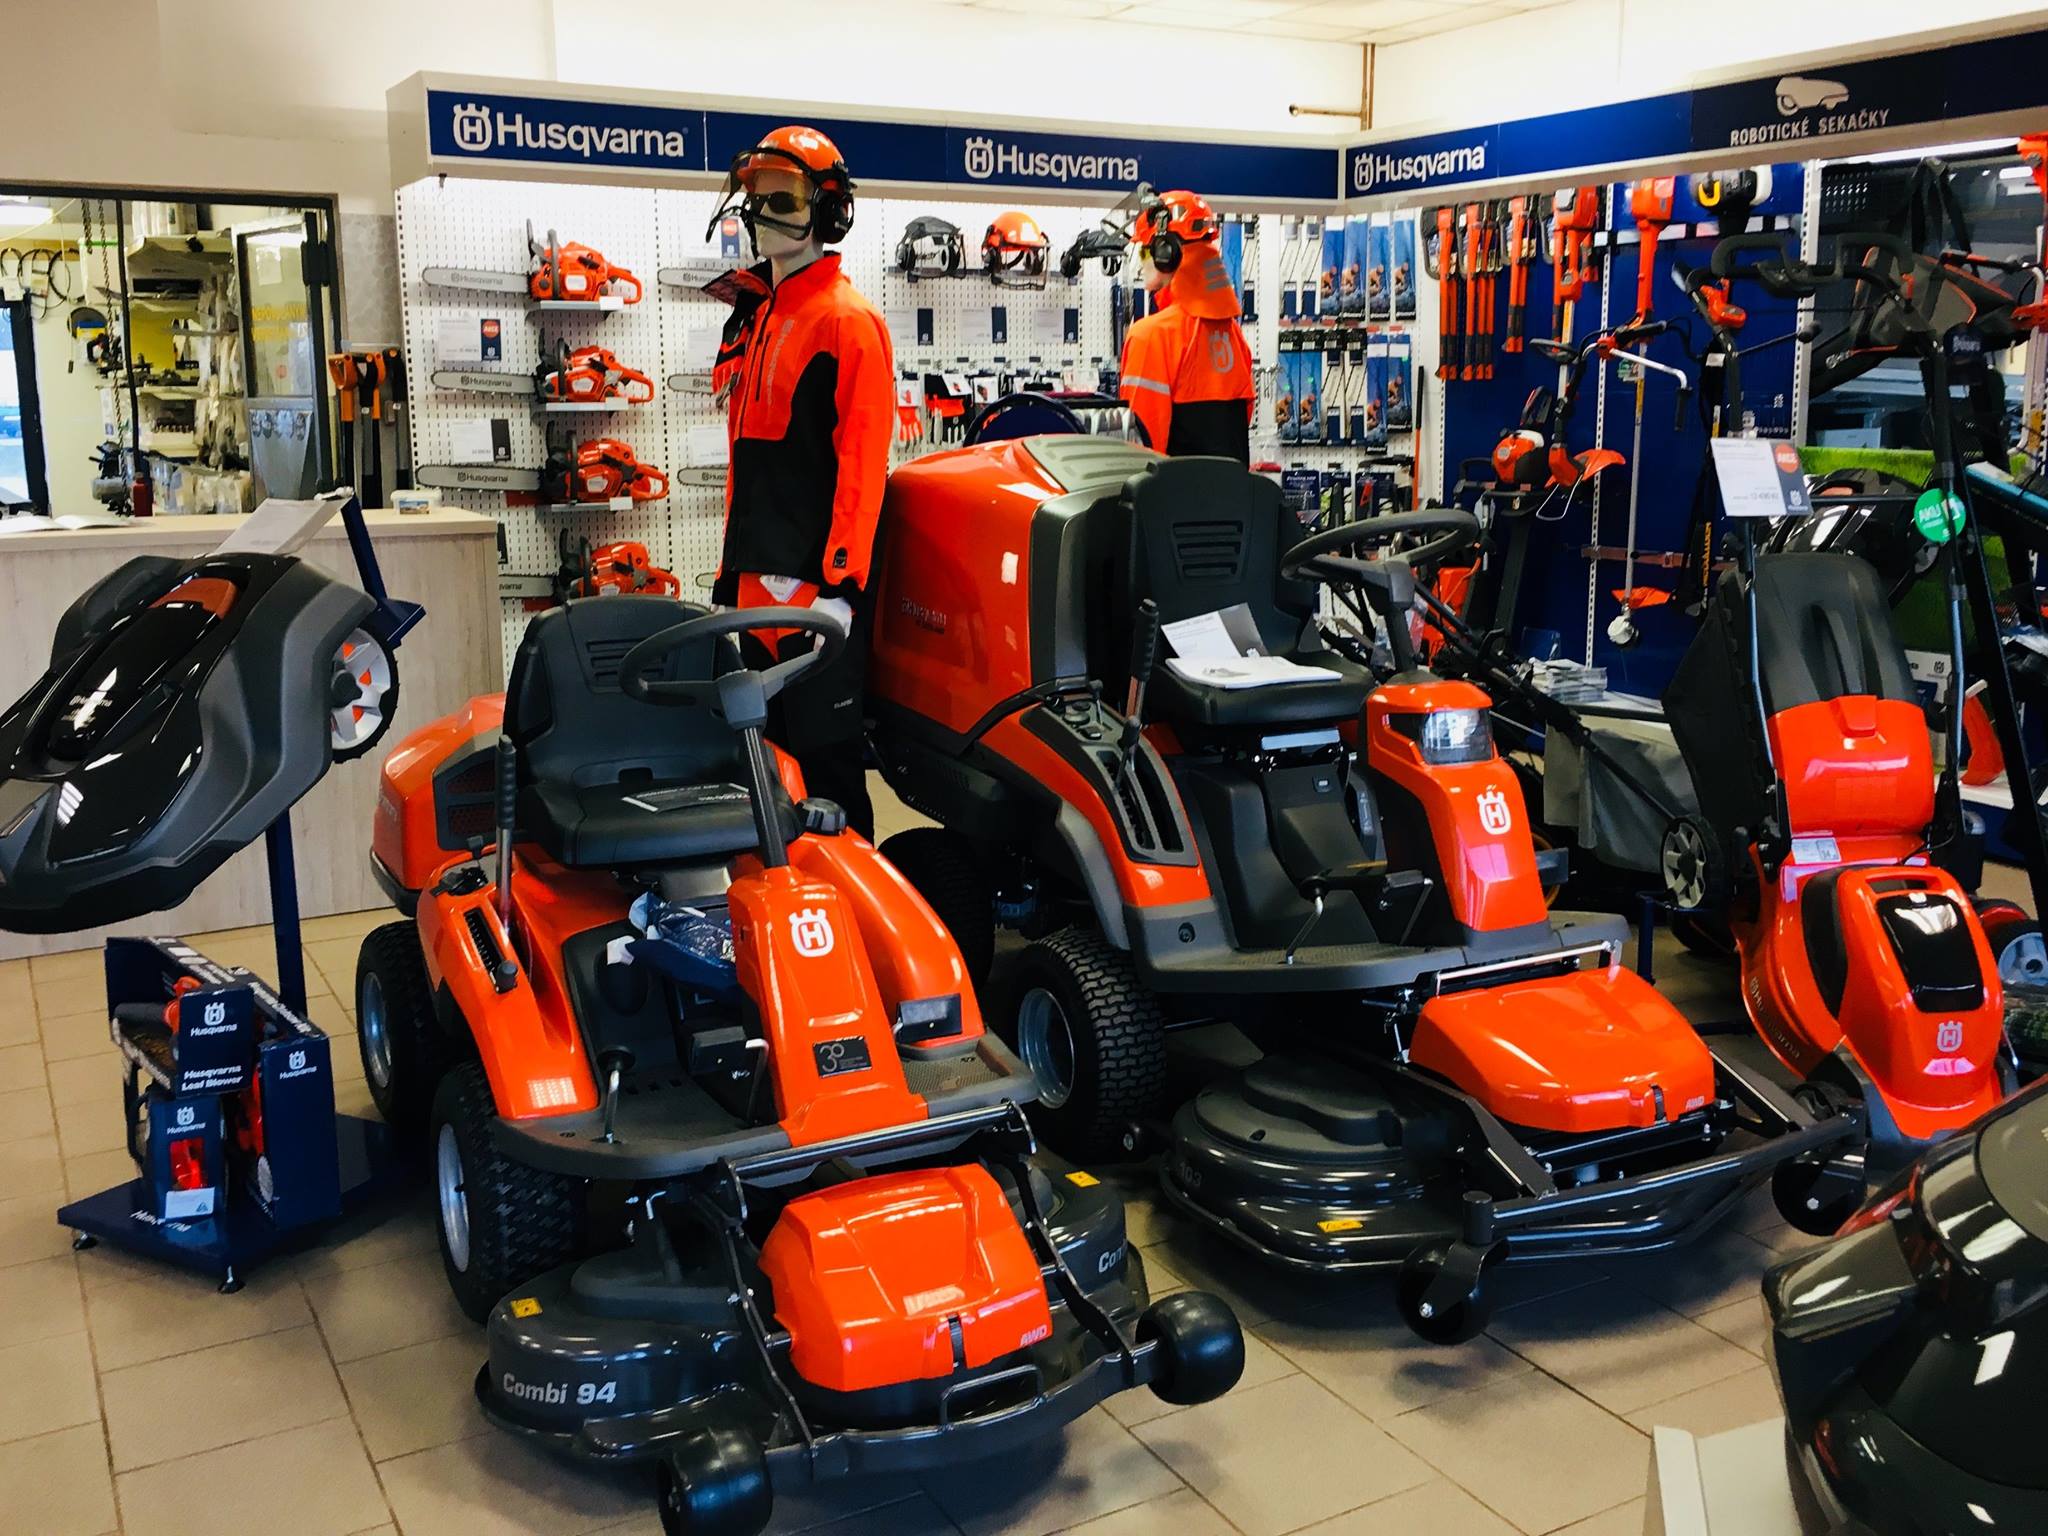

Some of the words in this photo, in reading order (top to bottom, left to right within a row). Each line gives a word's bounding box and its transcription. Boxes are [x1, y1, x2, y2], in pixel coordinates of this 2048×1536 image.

[496, 111, 684, 158] Husqvarna
[1730, 117, 1810, 147] ROBOTICKÉ
[1818, 108, 1890, 134] SEKAČKY
[997, 144, 1138, 182] Husqvarna
[1375, 145, 1485, 183] Husqvarna
[469, 376, 512, 387] Husqvarna
[466, 474, 508, 483] Husqvarna
[190, 1022, 238, 1037] Husqvarna
[183, 1064, 242, 1081] Husqvarna
[279, 1064, 317, 1080] Husqvarna
[166, 1120, 206, 1135] Husqvarna
[1020, 1324, 1047, 1348] AWD
[503, 1372, 568, 1404] Combi
[576, 1381, 617, 1405] 94
